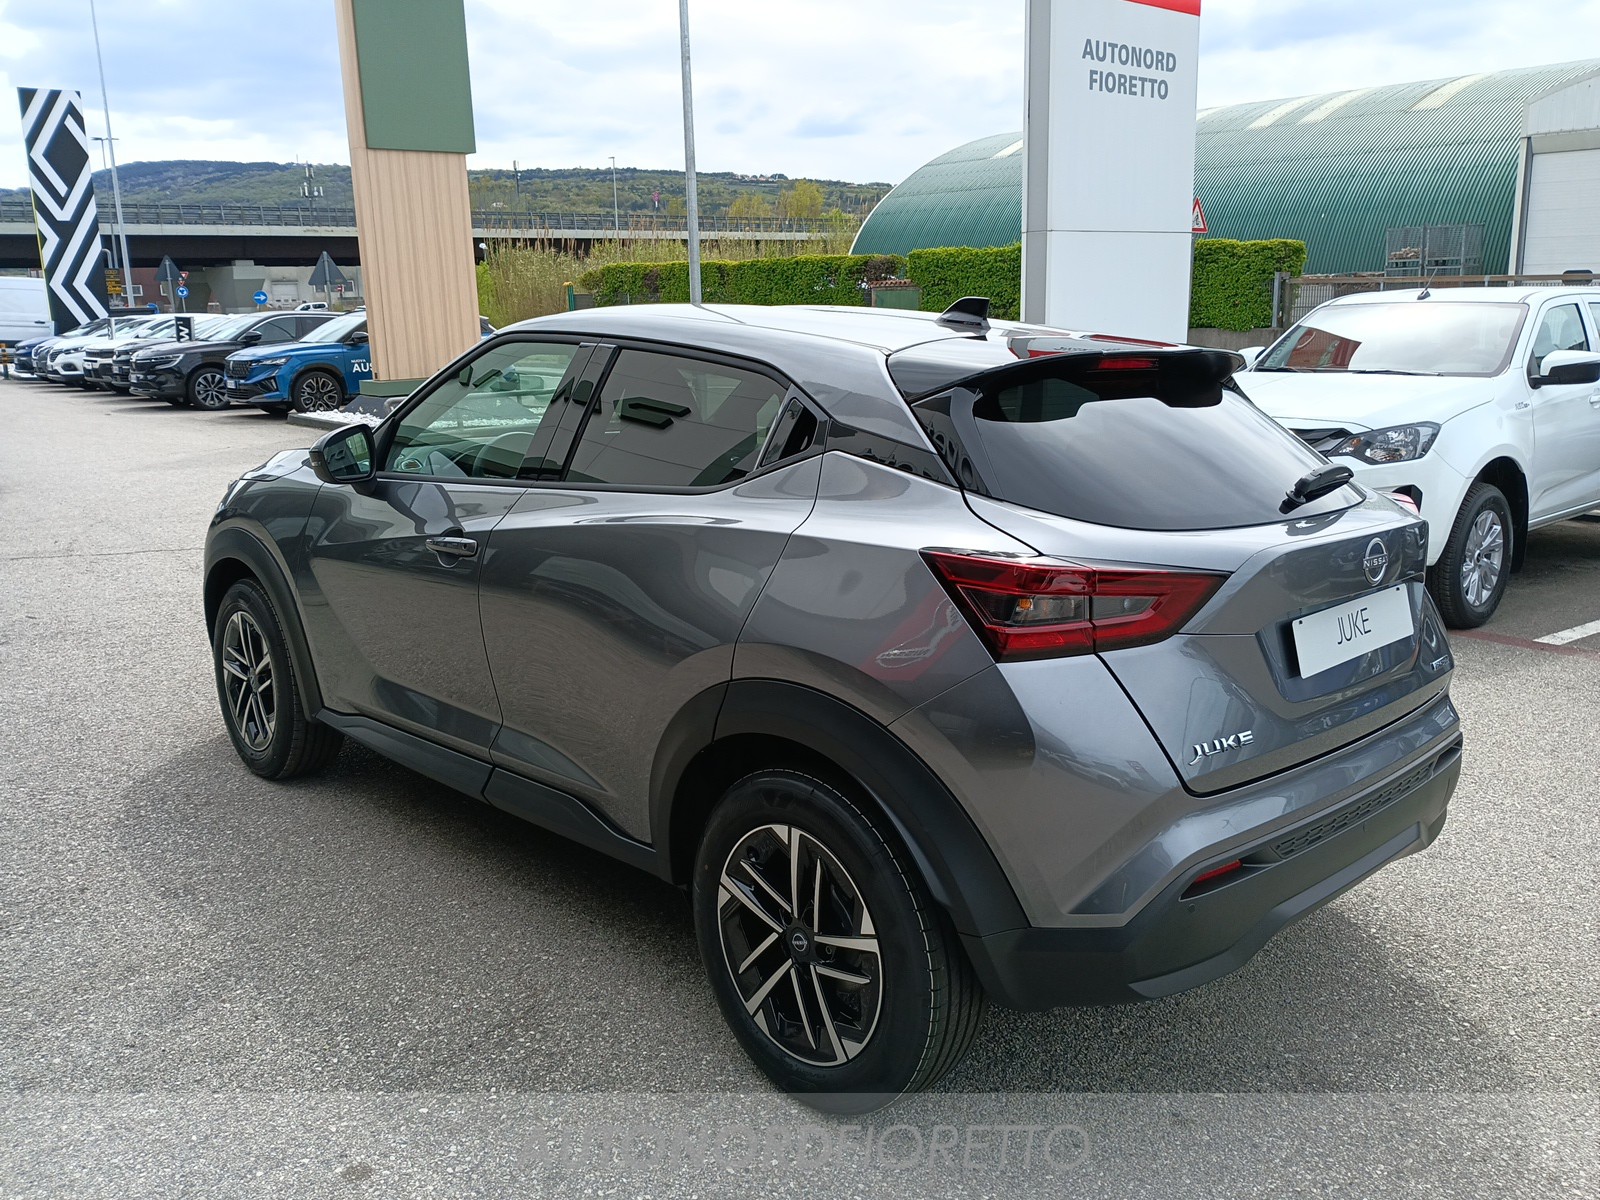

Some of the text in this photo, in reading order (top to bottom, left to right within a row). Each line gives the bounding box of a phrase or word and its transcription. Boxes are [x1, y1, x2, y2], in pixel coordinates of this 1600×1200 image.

[1082, 39, 1177, 72] AUTONORD
[1089, 69, 1168, 100] FIORETTO
[1337, 607, 1372, 645] JUKE
[1188, 730, 1254, 766] JUKE
